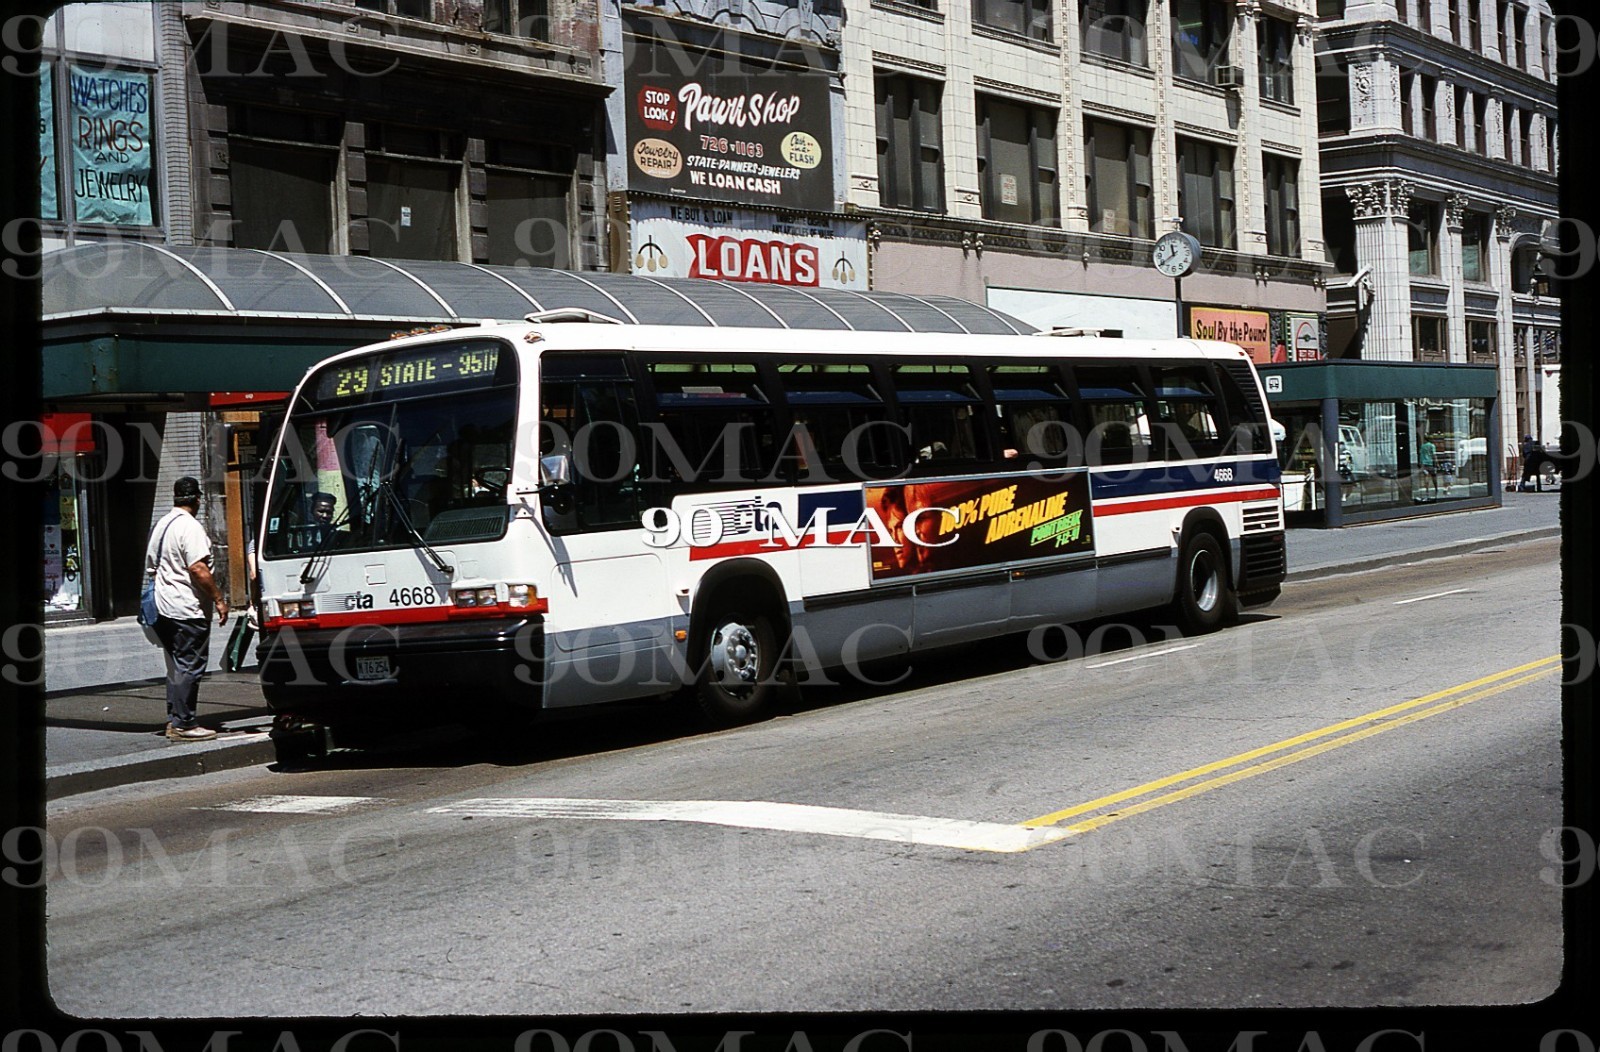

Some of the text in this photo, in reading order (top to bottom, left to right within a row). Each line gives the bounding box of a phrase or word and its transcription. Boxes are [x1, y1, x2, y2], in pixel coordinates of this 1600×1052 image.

[71, 74, 147, 114] WATCHES
[645, 90, 670, 105] STOP
[643, 106, 676, 124] LOOK!
[678, 82, 801, 131] Pawn Shop
[78, 116, 144, 152] RINGS
[95, 152, 130, 164] AND
[637, 142, 679, 167] Jewelry
[640, 156, 672, 170] REPAIR
[789, 152, 815, 164] FLASH
[75, 168, 147, 203] JEWELRY
[690, 170, 781, 195] WE LOAN CASH
[671, 206, 682, 219] WE
[685, 207, 700, 221] BUY
[697, 239, 816, 283] LOANS
[1196, 319, 1268, 342] Soul By the Pound
[336, 369, 368, 396] 29
[380, 357, 436, 386] STATE
[459, 348, 499, 376] 95TH
[1214, 467, 1234, 482] 4668
[978, 484, 1019, 521] PURE
[984, 491, 1069, 545] ADRENALINE
[345, 591, 374, 610] cta
[389, 586, 435, 606] 4668
